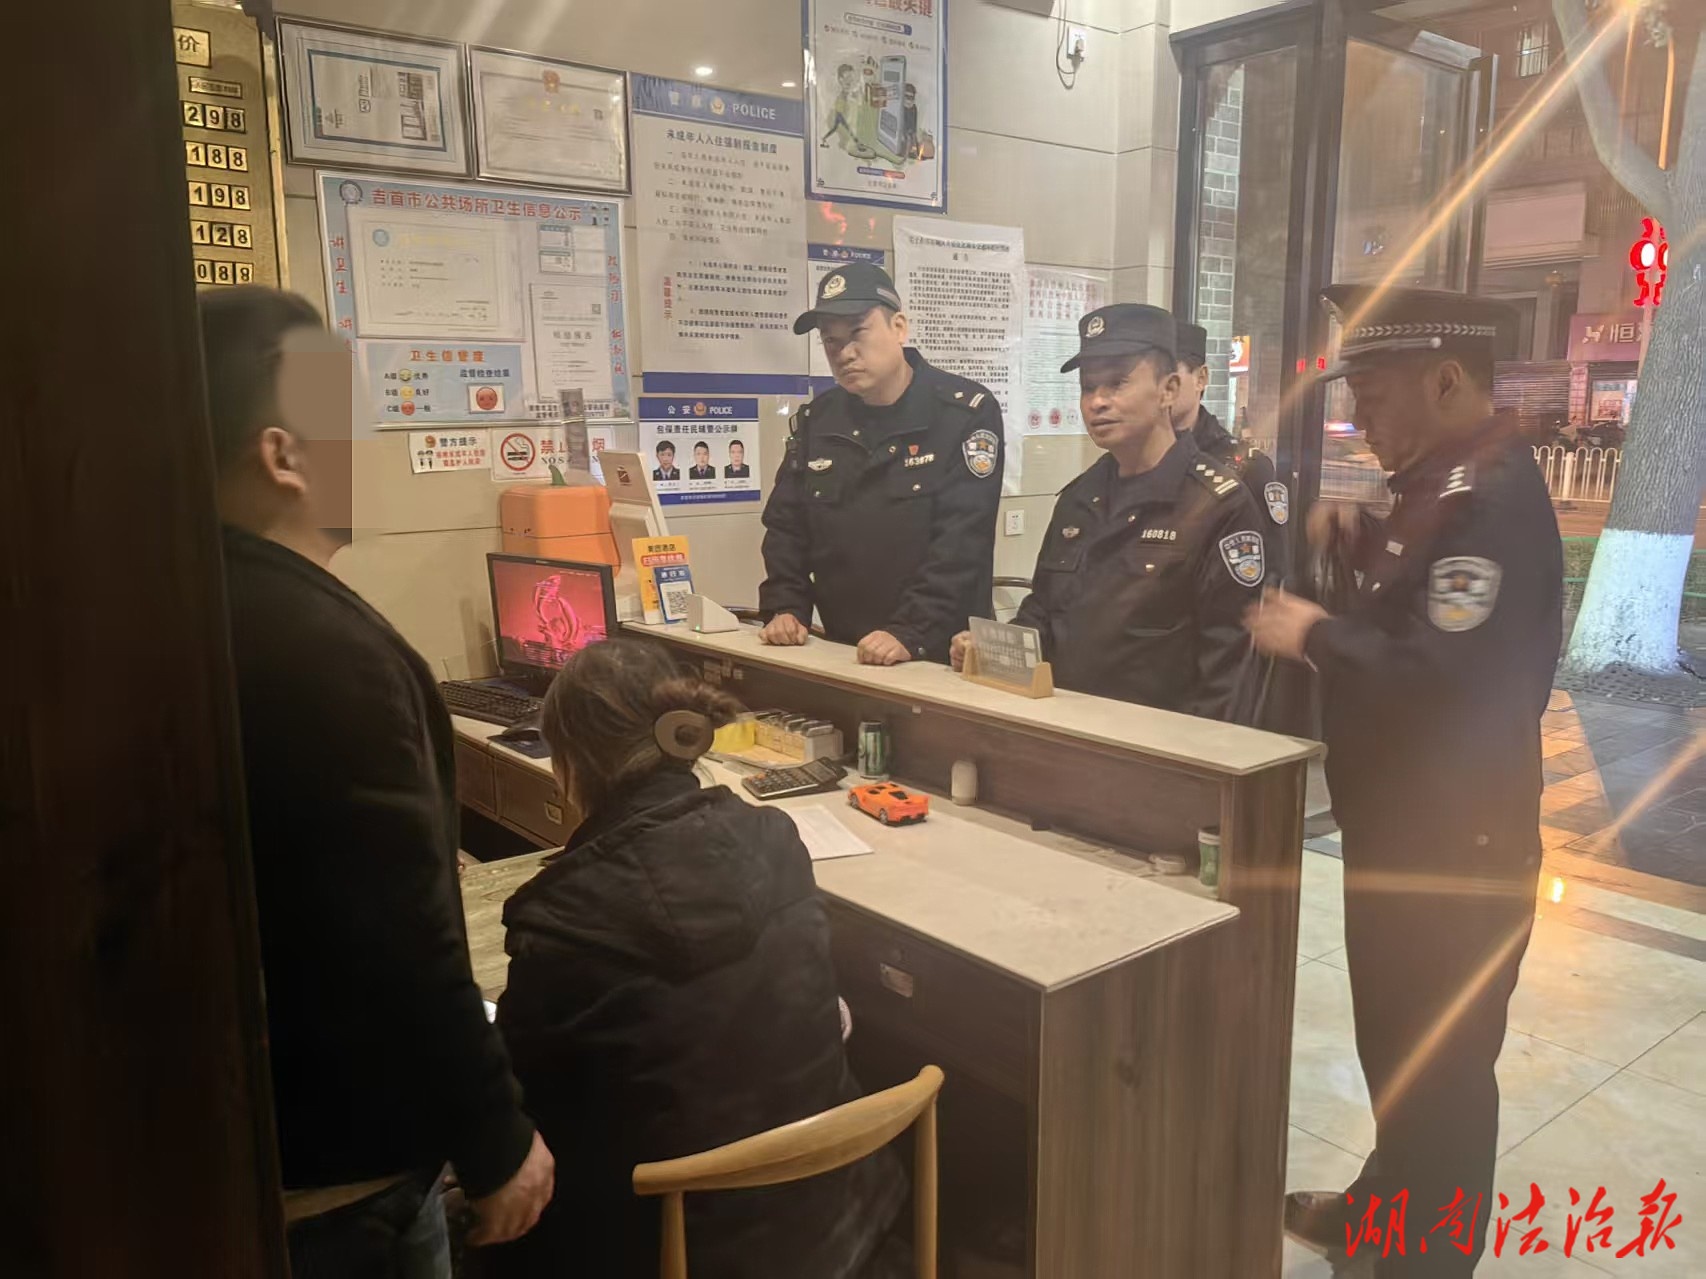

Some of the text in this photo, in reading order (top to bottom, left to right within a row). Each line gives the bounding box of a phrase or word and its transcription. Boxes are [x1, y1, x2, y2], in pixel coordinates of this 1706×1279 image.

[187, 105, 242, 130] 298
[732, 103, 777, 120] POLICE
[191, 148, 244, 167] 188
[194, 186, 246, 207] 198
[371, 187, 582, 222] 吉首市公共场所卫生信息公示
[196, 224, 249, 245] 128
[709, 406, 733, 415] POLICE
